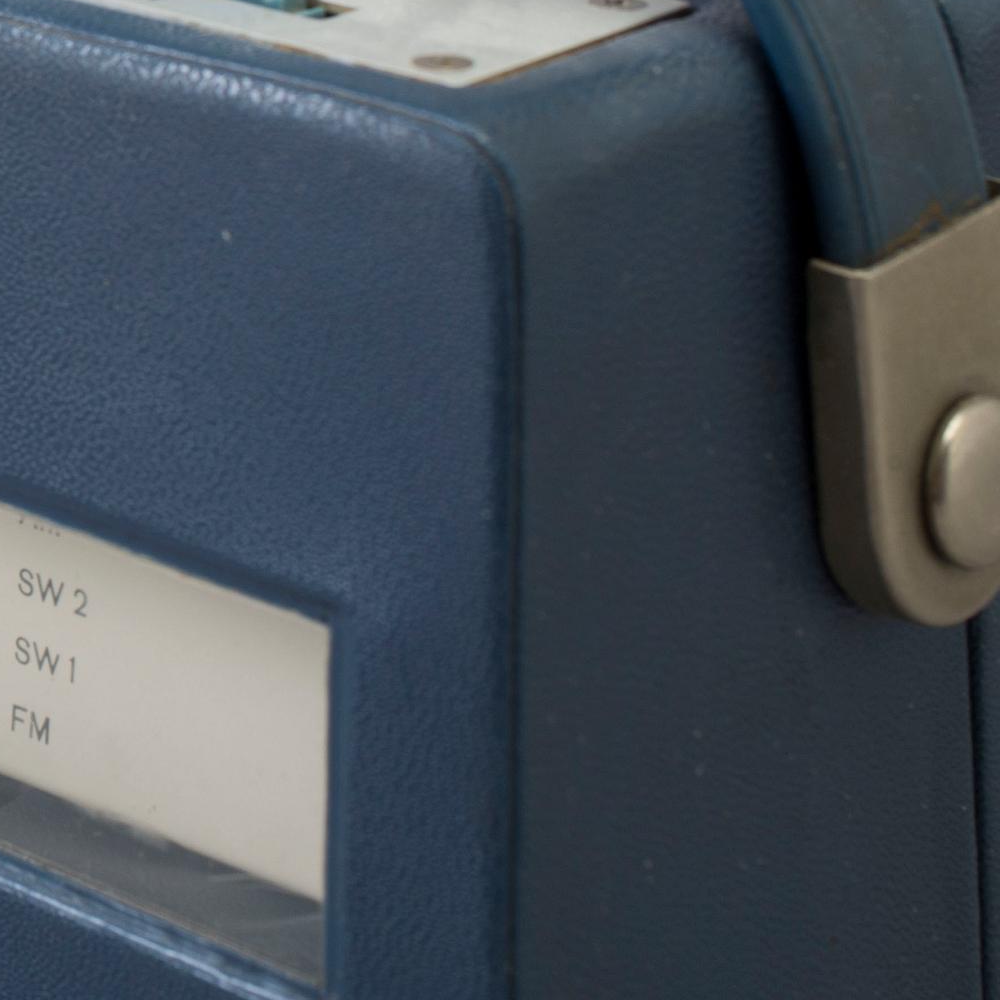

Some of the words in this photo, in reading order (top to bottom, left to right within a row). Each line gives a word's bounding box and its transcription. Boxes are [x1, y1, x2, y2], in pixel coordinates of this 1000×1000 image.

[18, 569, 62, 606] SW
[74, 592, 89, 617] 2
[10, 704, 51, 745] FM
